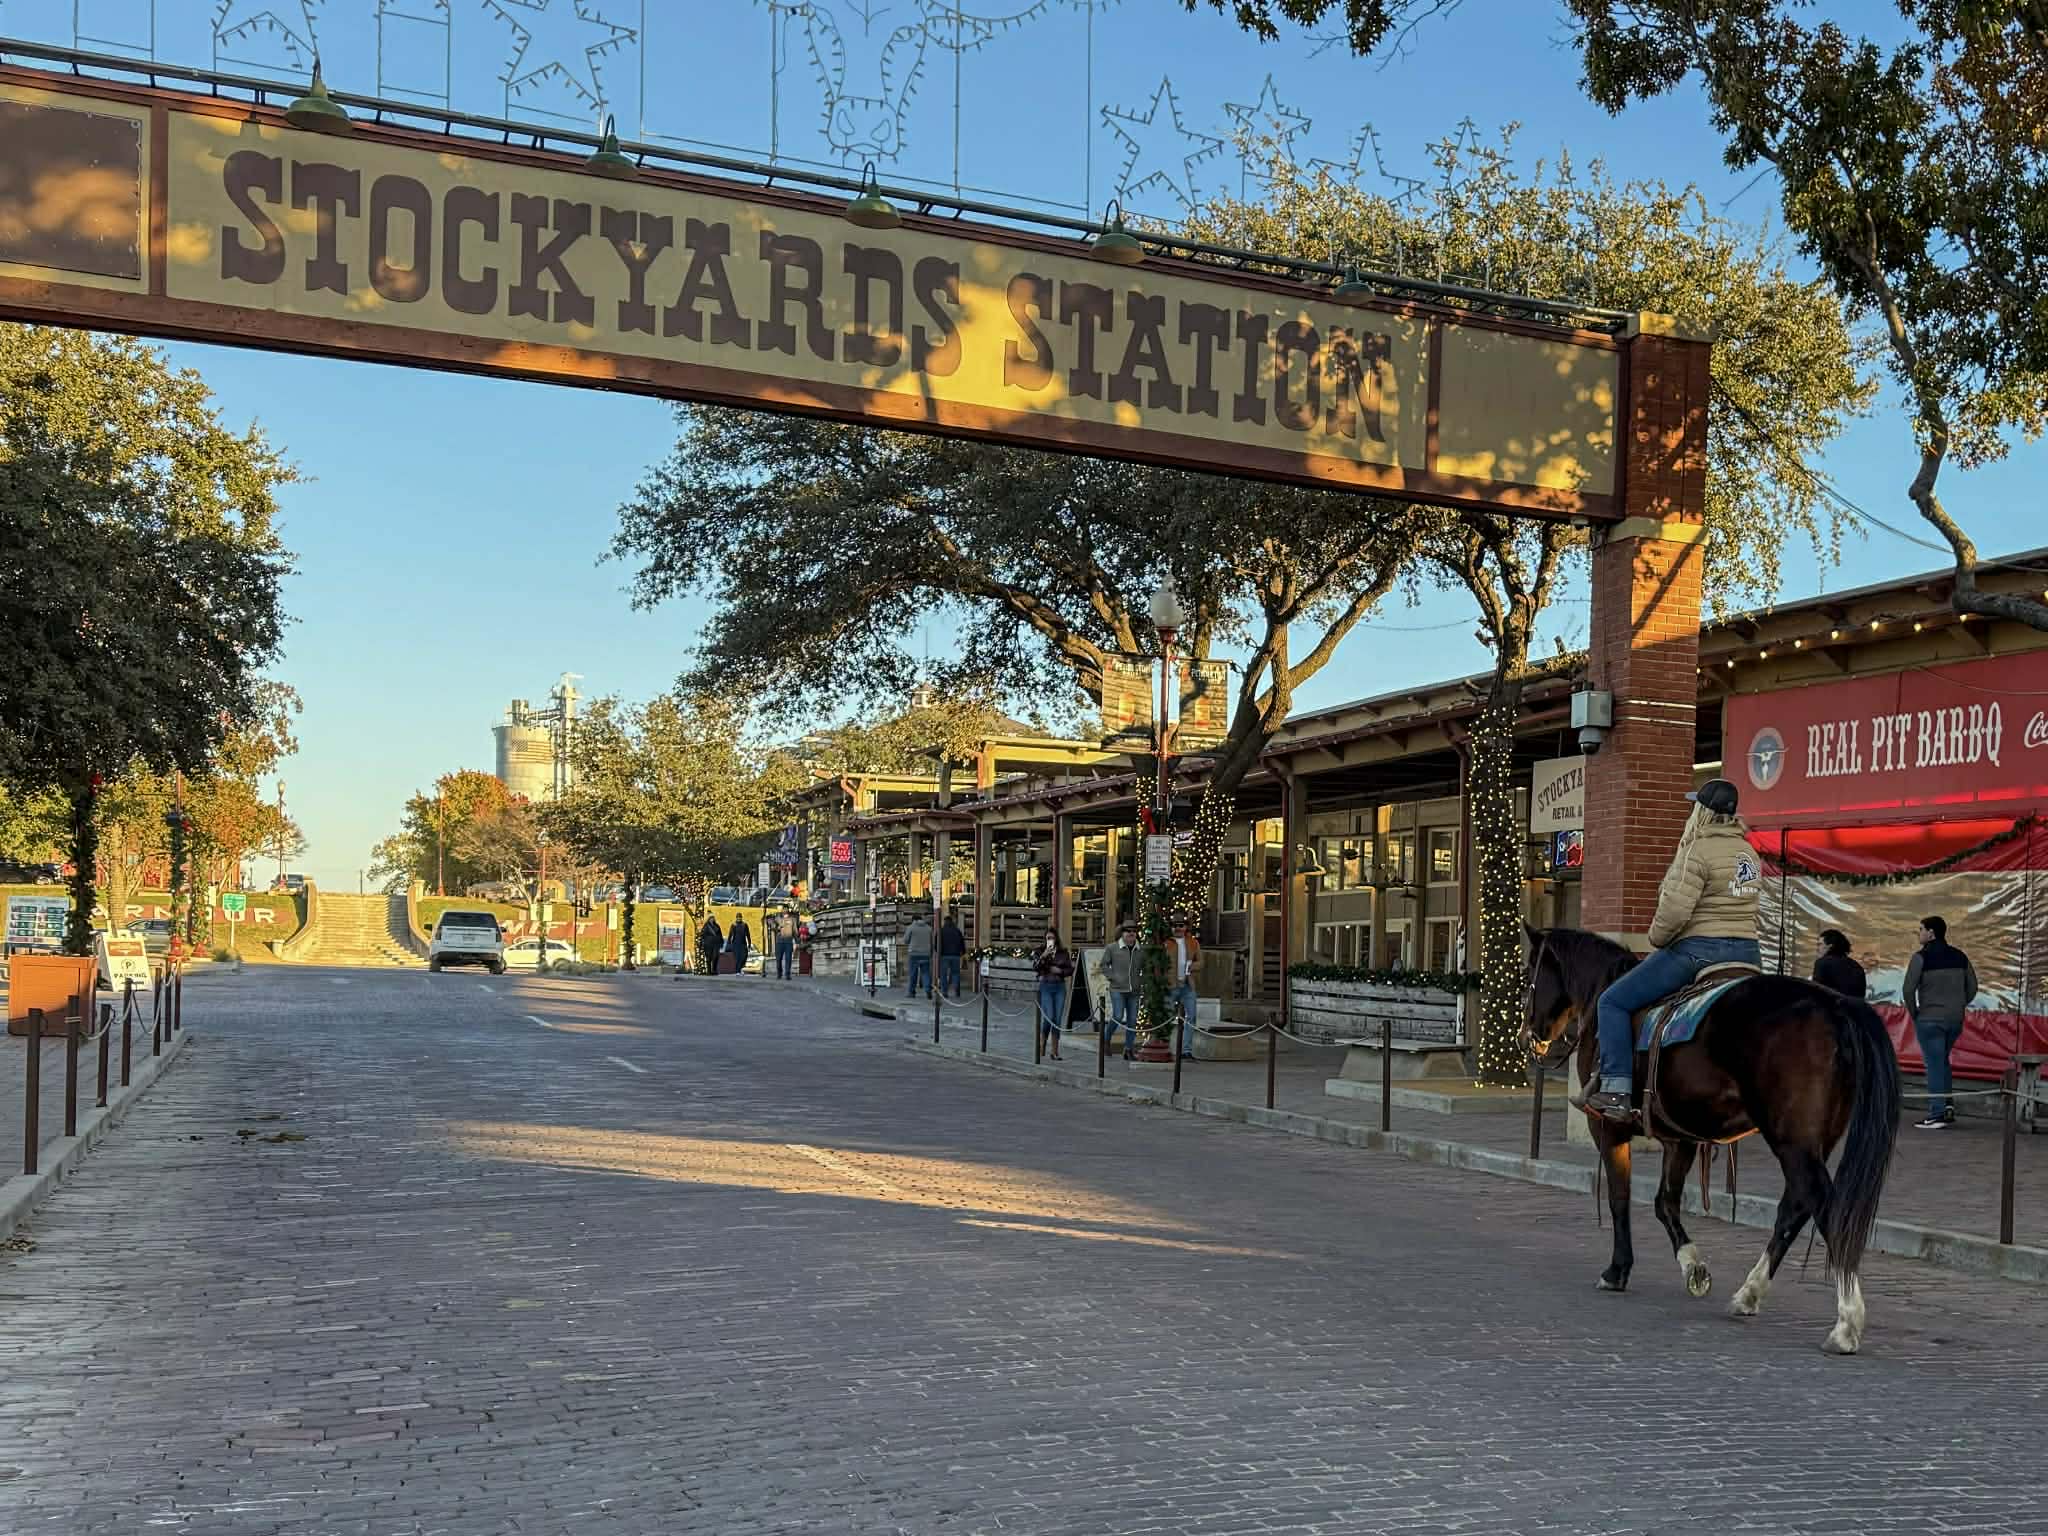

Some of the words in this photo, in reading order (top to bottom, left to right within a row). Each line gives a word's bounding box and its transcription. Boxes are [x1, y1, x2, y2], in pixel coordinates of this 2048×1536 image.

[222, 150, 963, 376] STOCKYARDS
[1003, 272, 1393, 441] STATION
[1806, 720, 1862, 777] REAL
[1869, 713, 1912, 773] PIT
[1552, 806, 1576, 820] RETAIL
